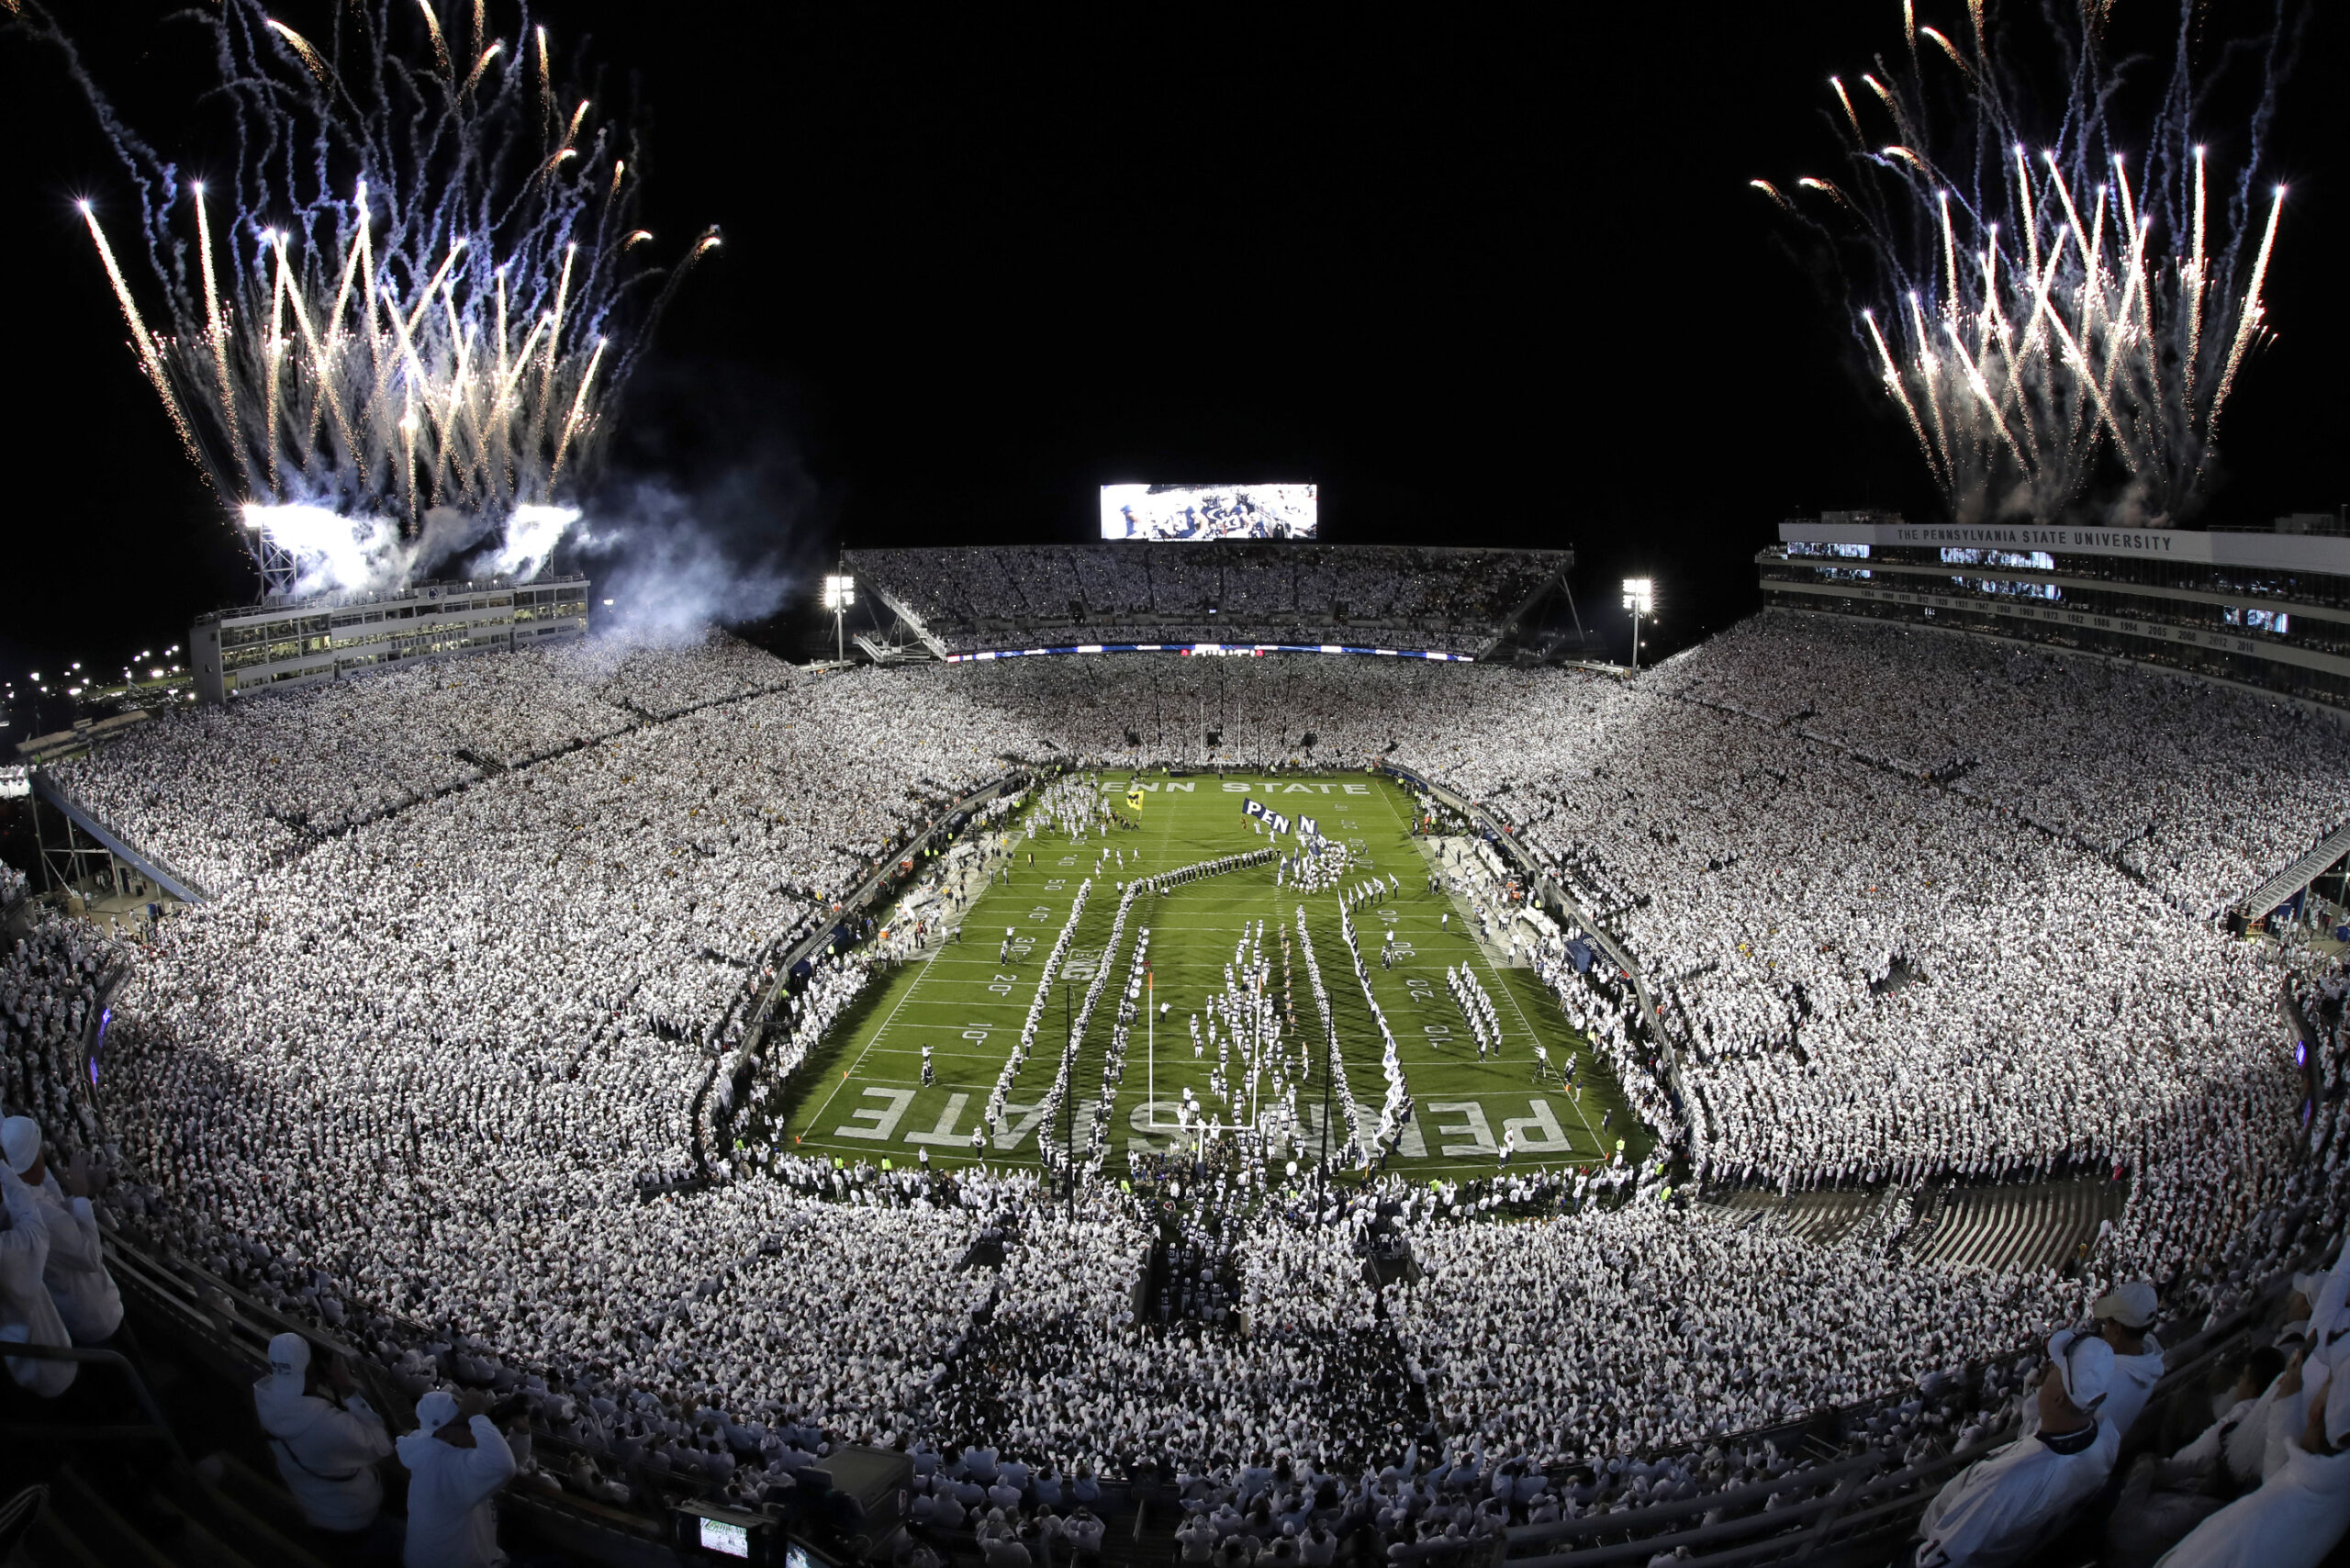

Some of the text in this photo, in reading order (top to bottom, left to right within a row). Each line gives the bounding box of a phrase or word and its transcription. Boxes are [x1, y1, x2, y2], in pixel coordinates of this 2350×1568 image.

[1897, 529, 2171, 551] THE PENNSYLVANIA STATE UNIVERSITY
[2120, 622, 2138, 632] 1994
[2148, 625, 2167, 637] 2005
[391, 630, 468, 650] BEAVER STADIUM
[1221, 781, 1371, 795] STATE
[1044, 879, 1066, 890] 50
[1010, 936, 1036, 952] 30
[1391, 941, 1416, 957] 30
[989, 974, 1018, 991] 20
[1406, 980, 1435, 998] 20
[962, 1023, 993, 1039] 10
[1424, 1025, 1454, 1041] 10
[834, 1087, 1202, 1157] STATE
[1263, 1099, 1573, 1159] PENN
[1920, 1539, 1952, 1568] 17
